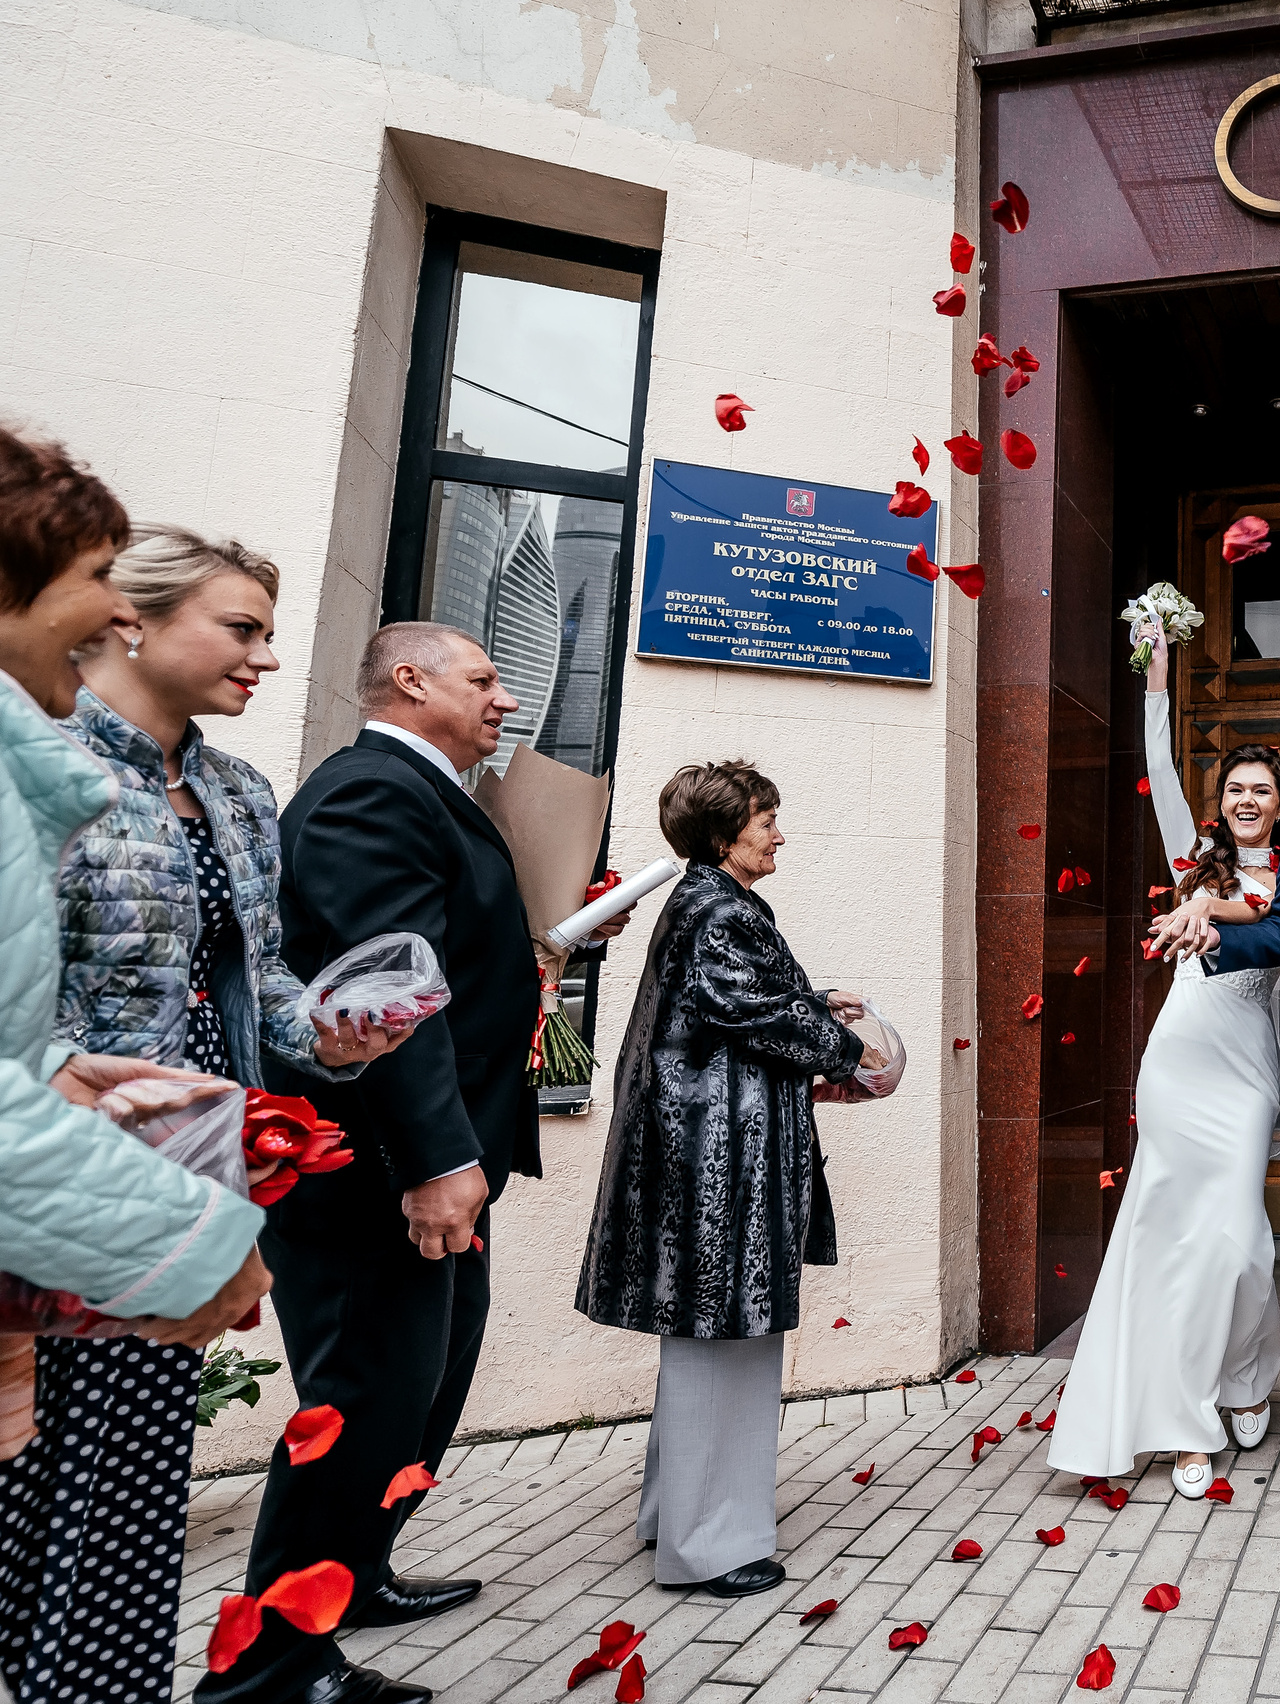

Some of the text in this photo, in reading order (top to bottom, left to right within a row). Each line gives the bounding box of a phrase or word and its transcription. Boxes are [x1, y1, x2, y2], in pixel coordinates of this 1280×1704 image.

[670, 511, 731, 526] Управление
[733, 520, 768, 531] записи
[771, 526, 799, 535] актов
[801, 529, 869, 544] гражданского
[742, 513, 855, 535] Правительство Москвы
[760, 531, 836, 547] города Москвы
[713, 541, 878, 575] КУТУЗОВСКИЙ
[731, 565, 859, 591] отдел ЗАГС
[665, 591, 730, 606] ВТОРНИК,
[750, 588, 839, 607] ЧАСЫ РАБОТЫ
[664, 602, 774, 622] СРЕДА, ЧЕТВЕРГ,
[664, 613, 792, 634] ПЯТНИЦА, СУББОТА
[817, 619, 914, 637] с 09.00 до 18.00
[687, 632, 891, 660] ЧЕТВЕРТЫЙ ЧЕТВЕРГ КАЖДОГО МЕСЯЦА
[731, 647, 850, 666] САНИТАРНЫЙ ДЕНЬ
